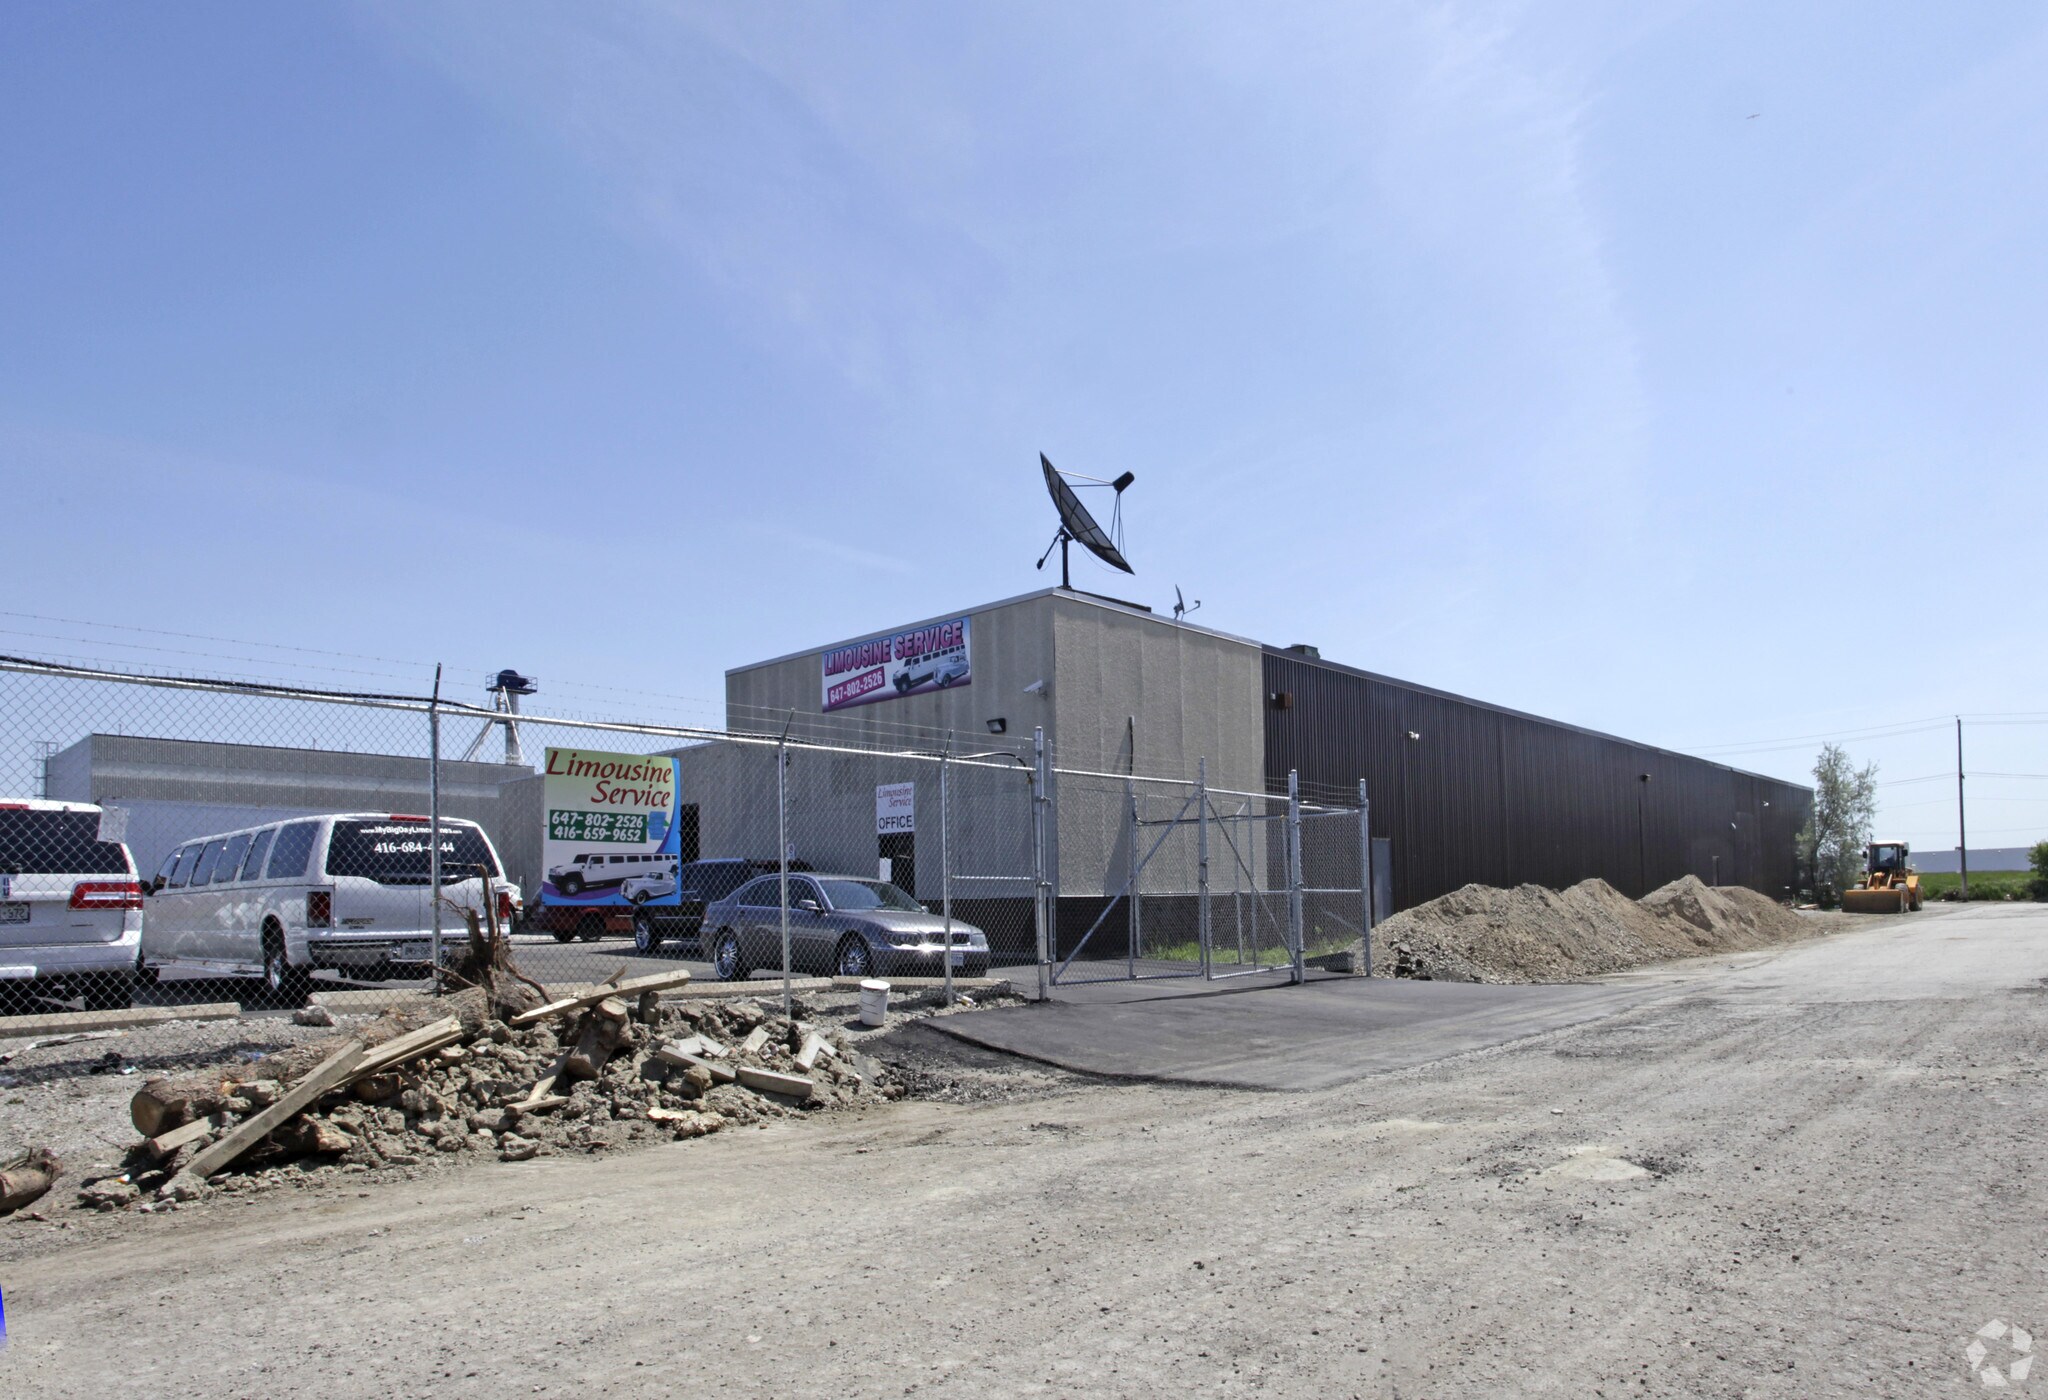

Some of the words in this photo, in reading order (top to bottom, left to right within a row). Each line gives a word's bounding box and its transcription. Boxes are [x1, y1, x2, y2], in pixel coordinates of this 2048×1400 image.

[824, 638, 891, 677] LIMOUSINE
[894, 620, 963, 660] SERVICE
[830, 671, 883, 703] 647-802-2526
[546, 750, 672, 783] Limousine
[590, 780, 671, 807] Service
[551, 811, 644, 829] 647-802-2526
[878, 814, 913, 830] OFFICE
[553, 825, 642, 842] 416-659-9652
[374, 841, 455, 854] 416-684-444
